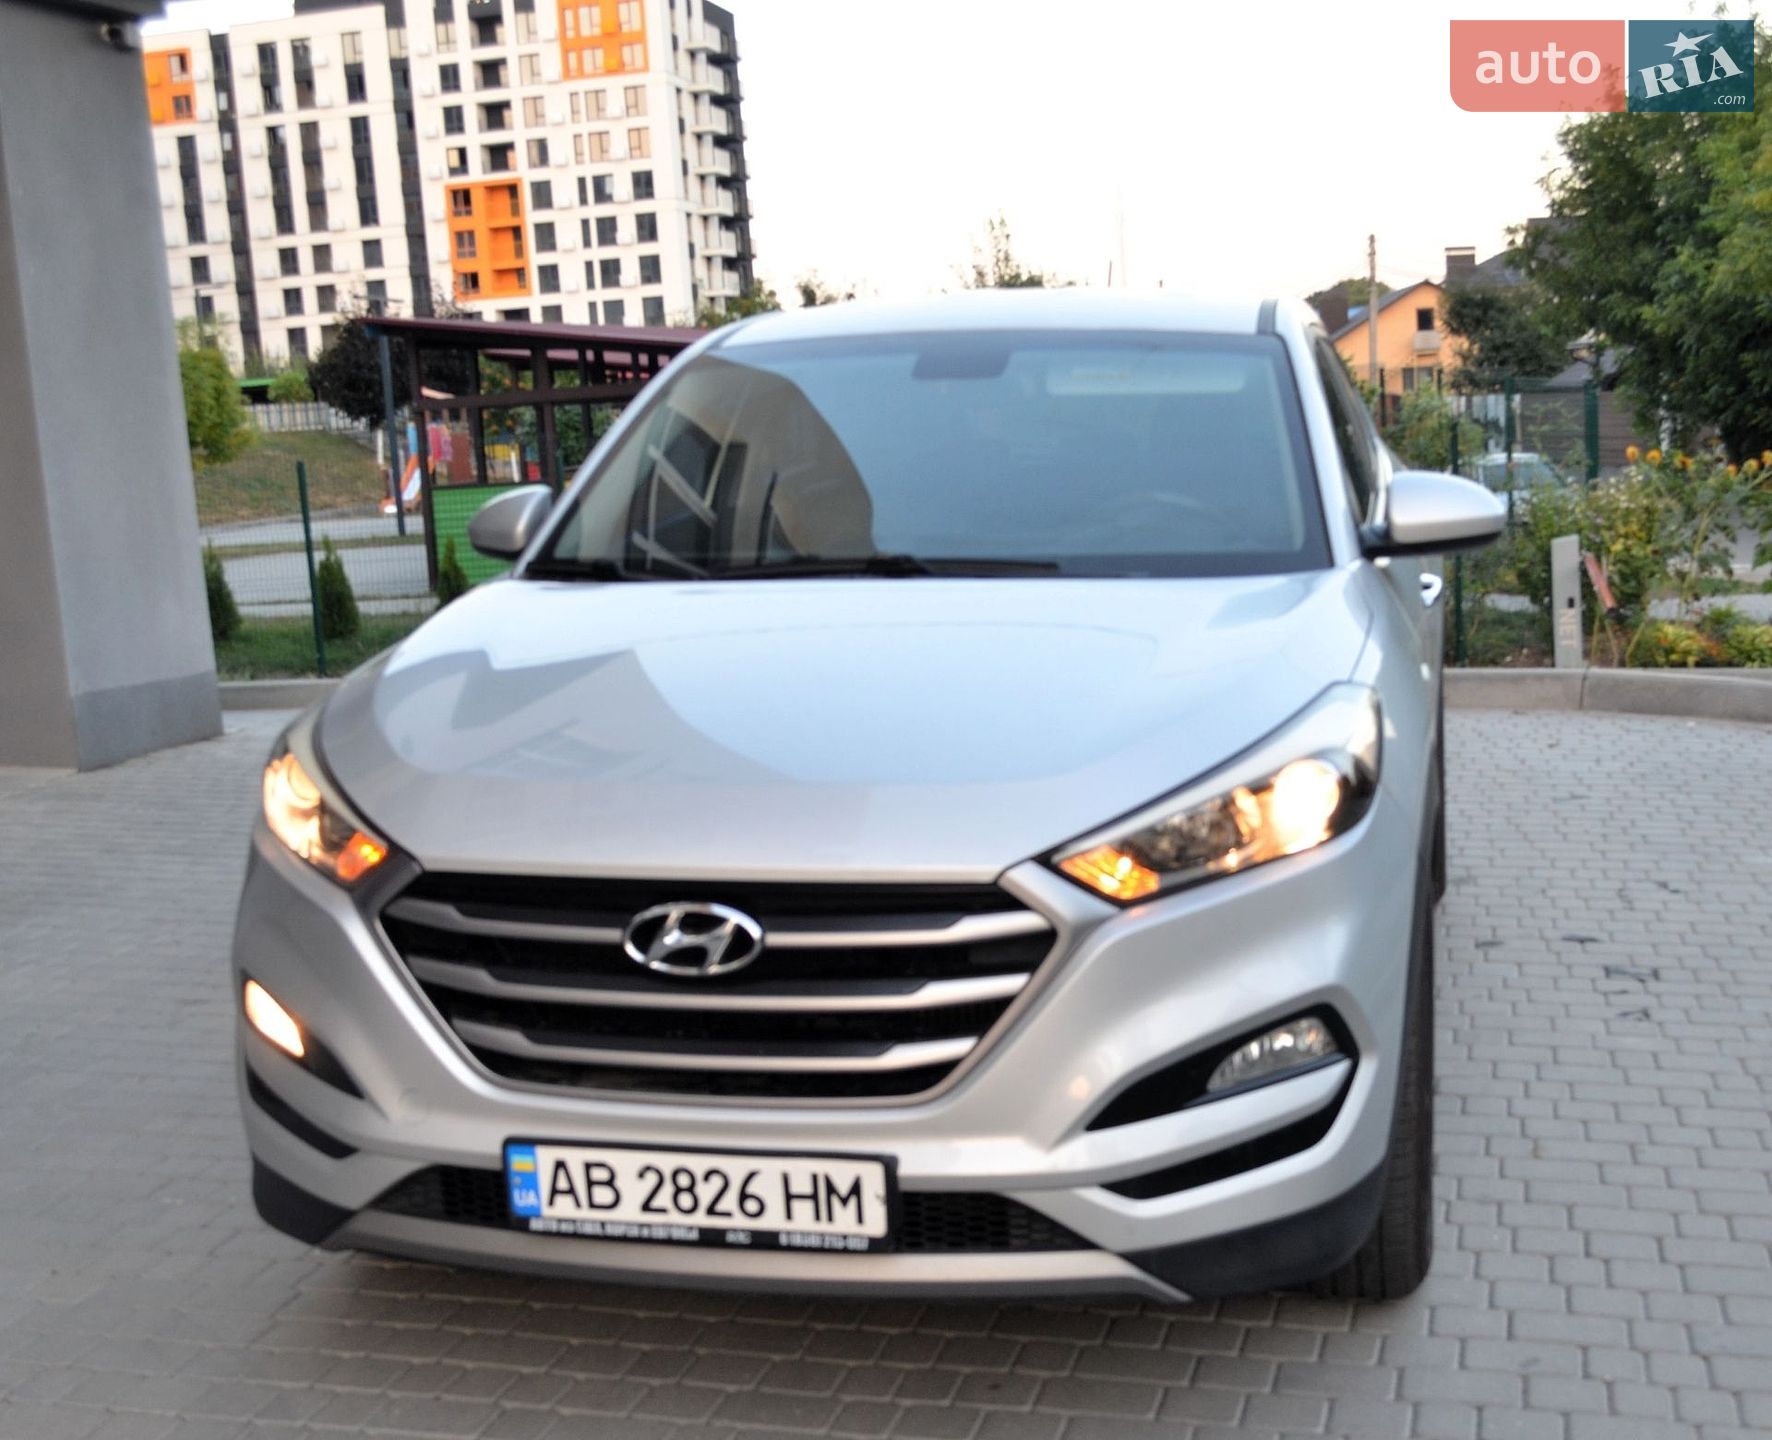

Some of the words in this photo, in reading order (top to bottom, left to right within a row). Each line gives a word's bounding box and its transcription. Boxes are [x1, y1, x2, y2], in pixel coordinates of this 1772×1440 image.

[513, 1189, 539, 1208] UA
[548, 1159, 621, 1210] AB
[637, 1165, 766, 1218] 2826
[781, 1171, 864, 1224] HM
